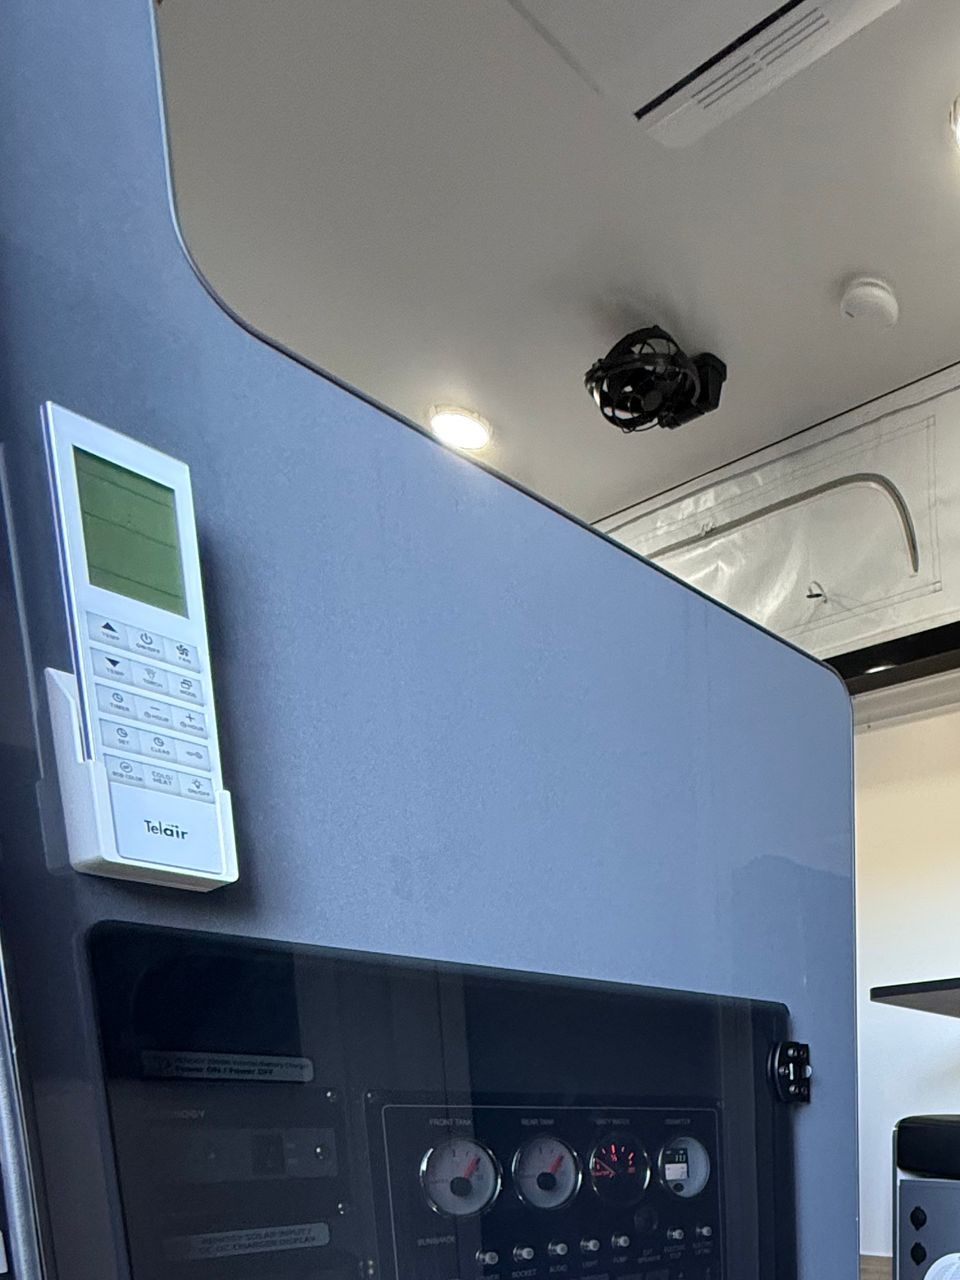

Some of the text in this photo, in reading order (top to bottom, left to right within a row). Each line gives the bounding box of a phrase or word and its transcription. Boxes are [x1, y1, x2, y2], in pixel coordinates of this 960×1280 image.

[109, 702, 130, 712] TIMER
[150, 746, 170, 756] CLEAR
[152, 777, 172, 787] HEAT
[143, 818, 189, 841] Telair
[429, 1117, 453, 1127] FRONT
[512, 1268, 537, 1279] SOCKET
